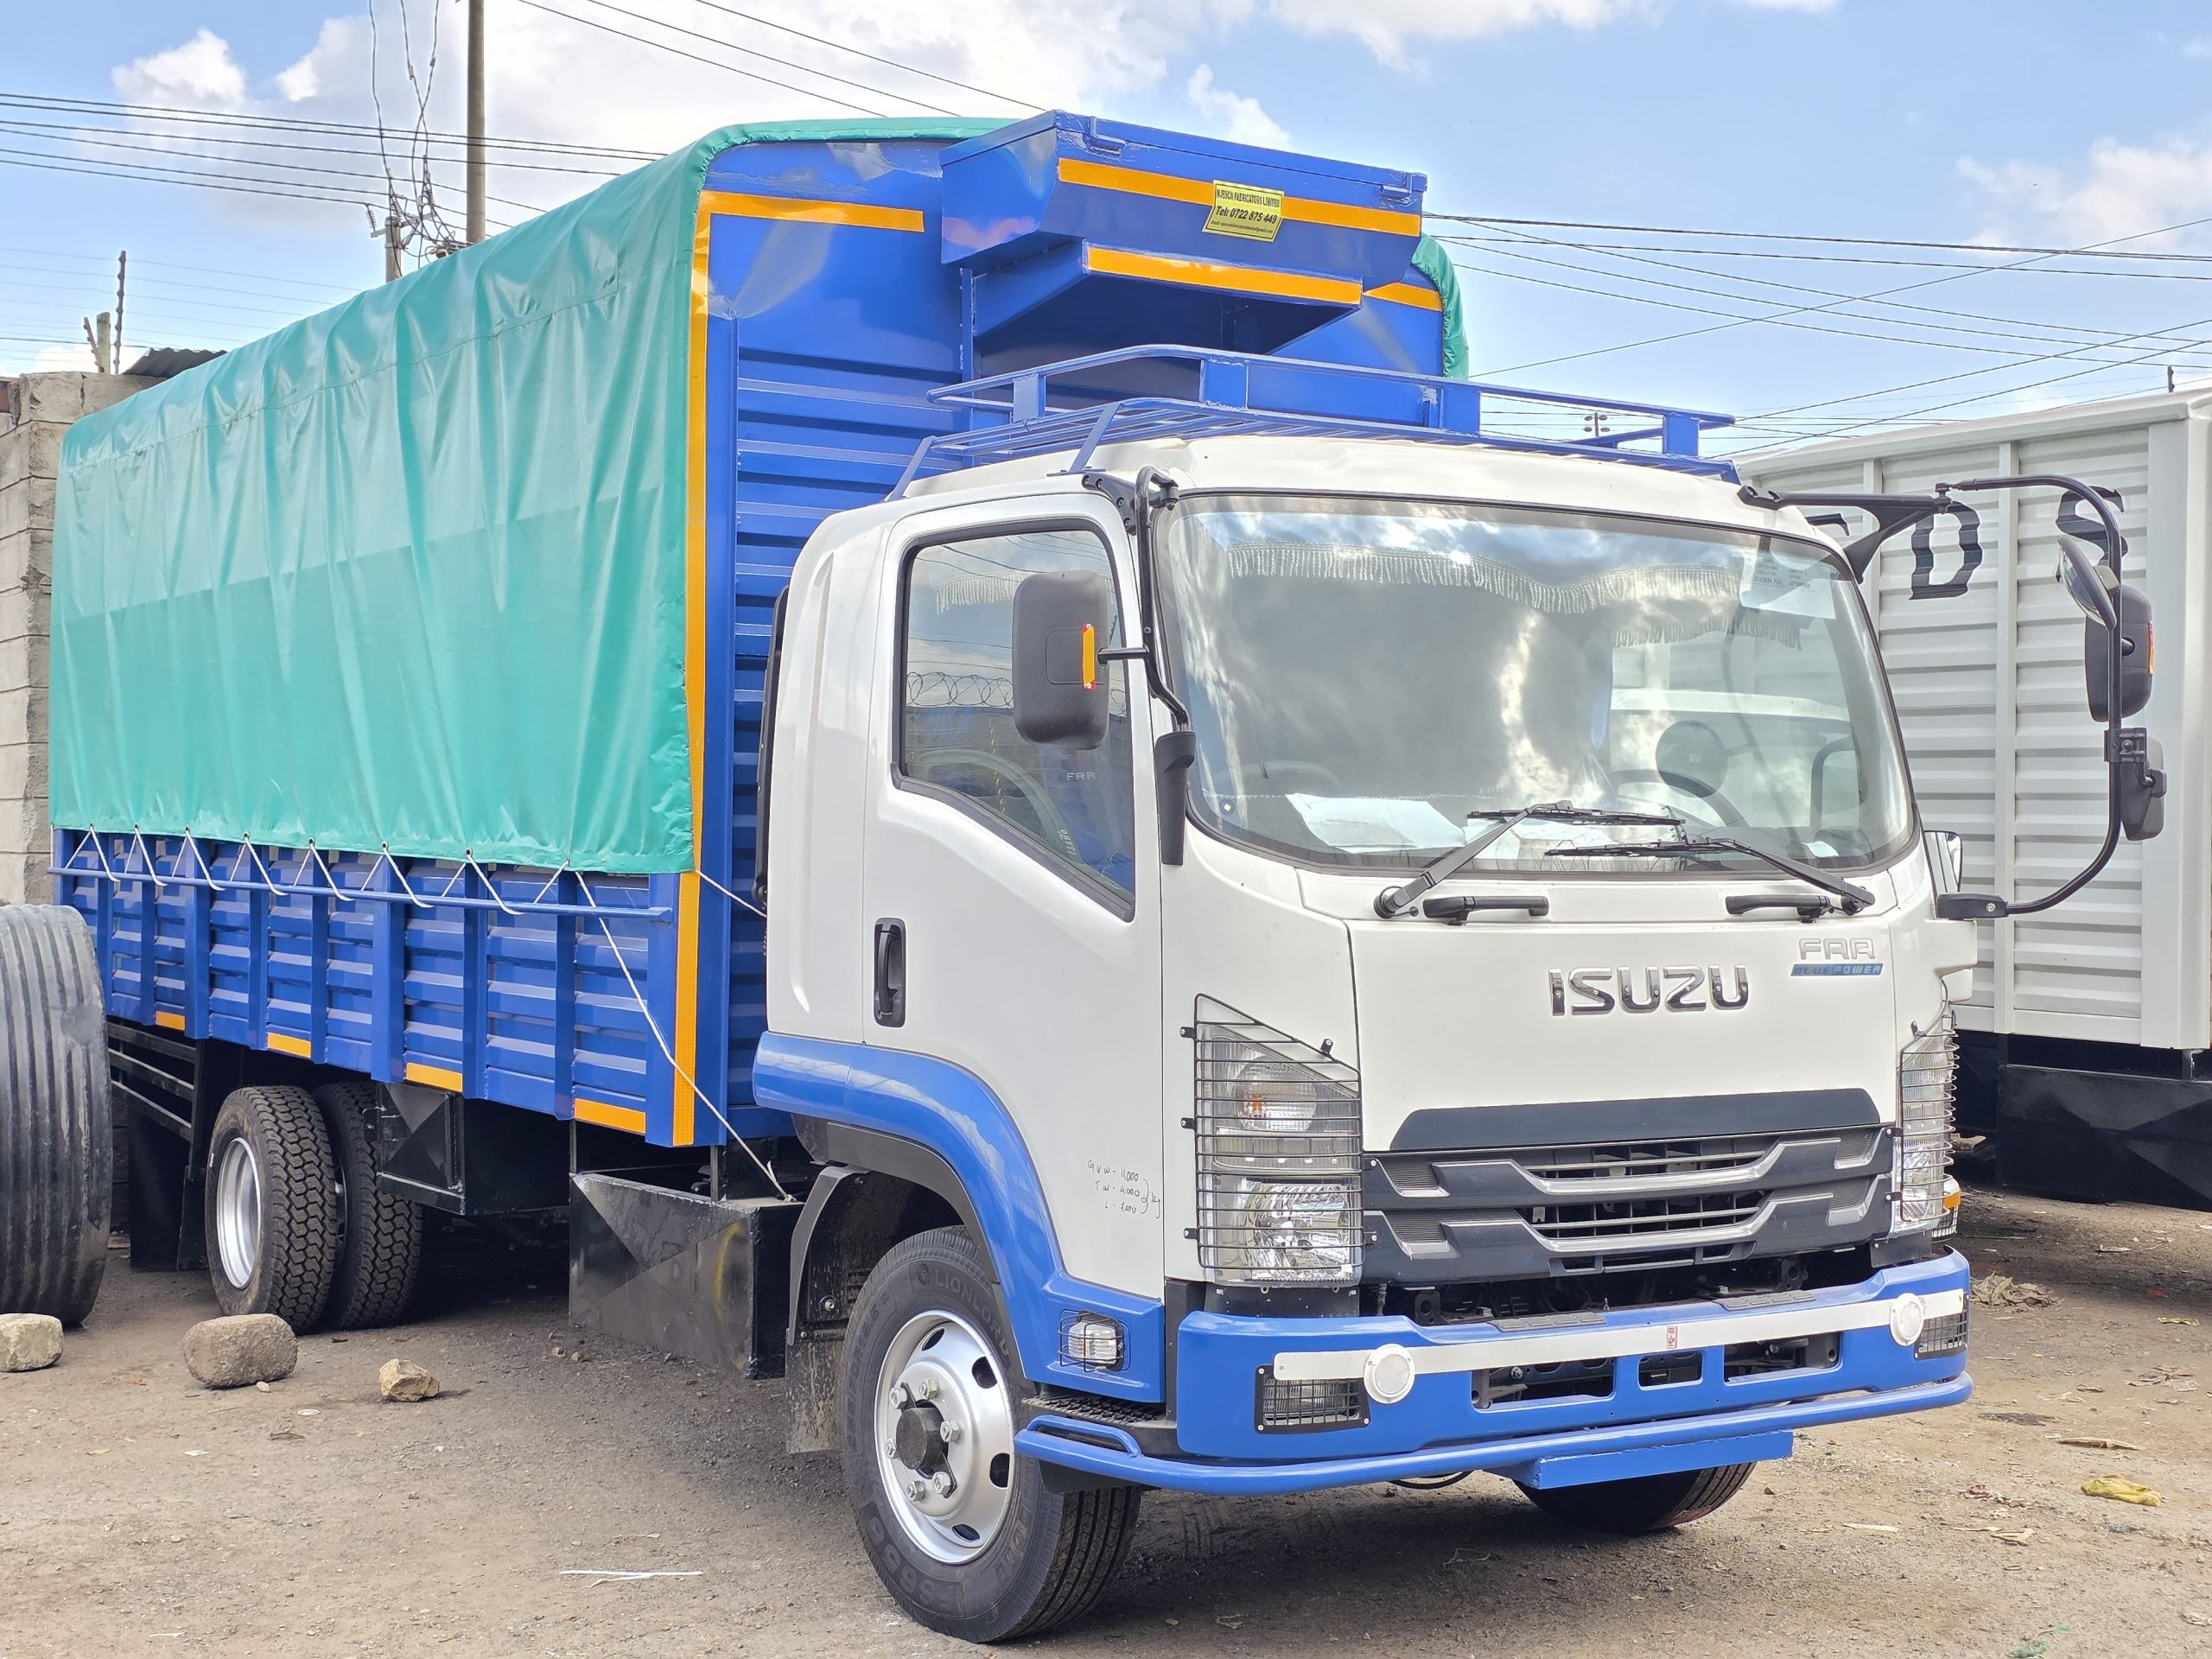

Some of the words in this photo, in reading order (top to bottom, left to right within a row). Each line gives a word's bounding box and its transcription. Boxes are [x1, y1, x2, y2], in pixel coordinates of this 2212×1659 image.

[1230, 208, 1249, 220] 0722
[1263, 213, 1277, 224] 449
[1263, 197, 1280, 207] LIMITED
[1548, 963, 1750, 1017] ISUZU
[935, 1268, 1010, 1357] LIONLORD
